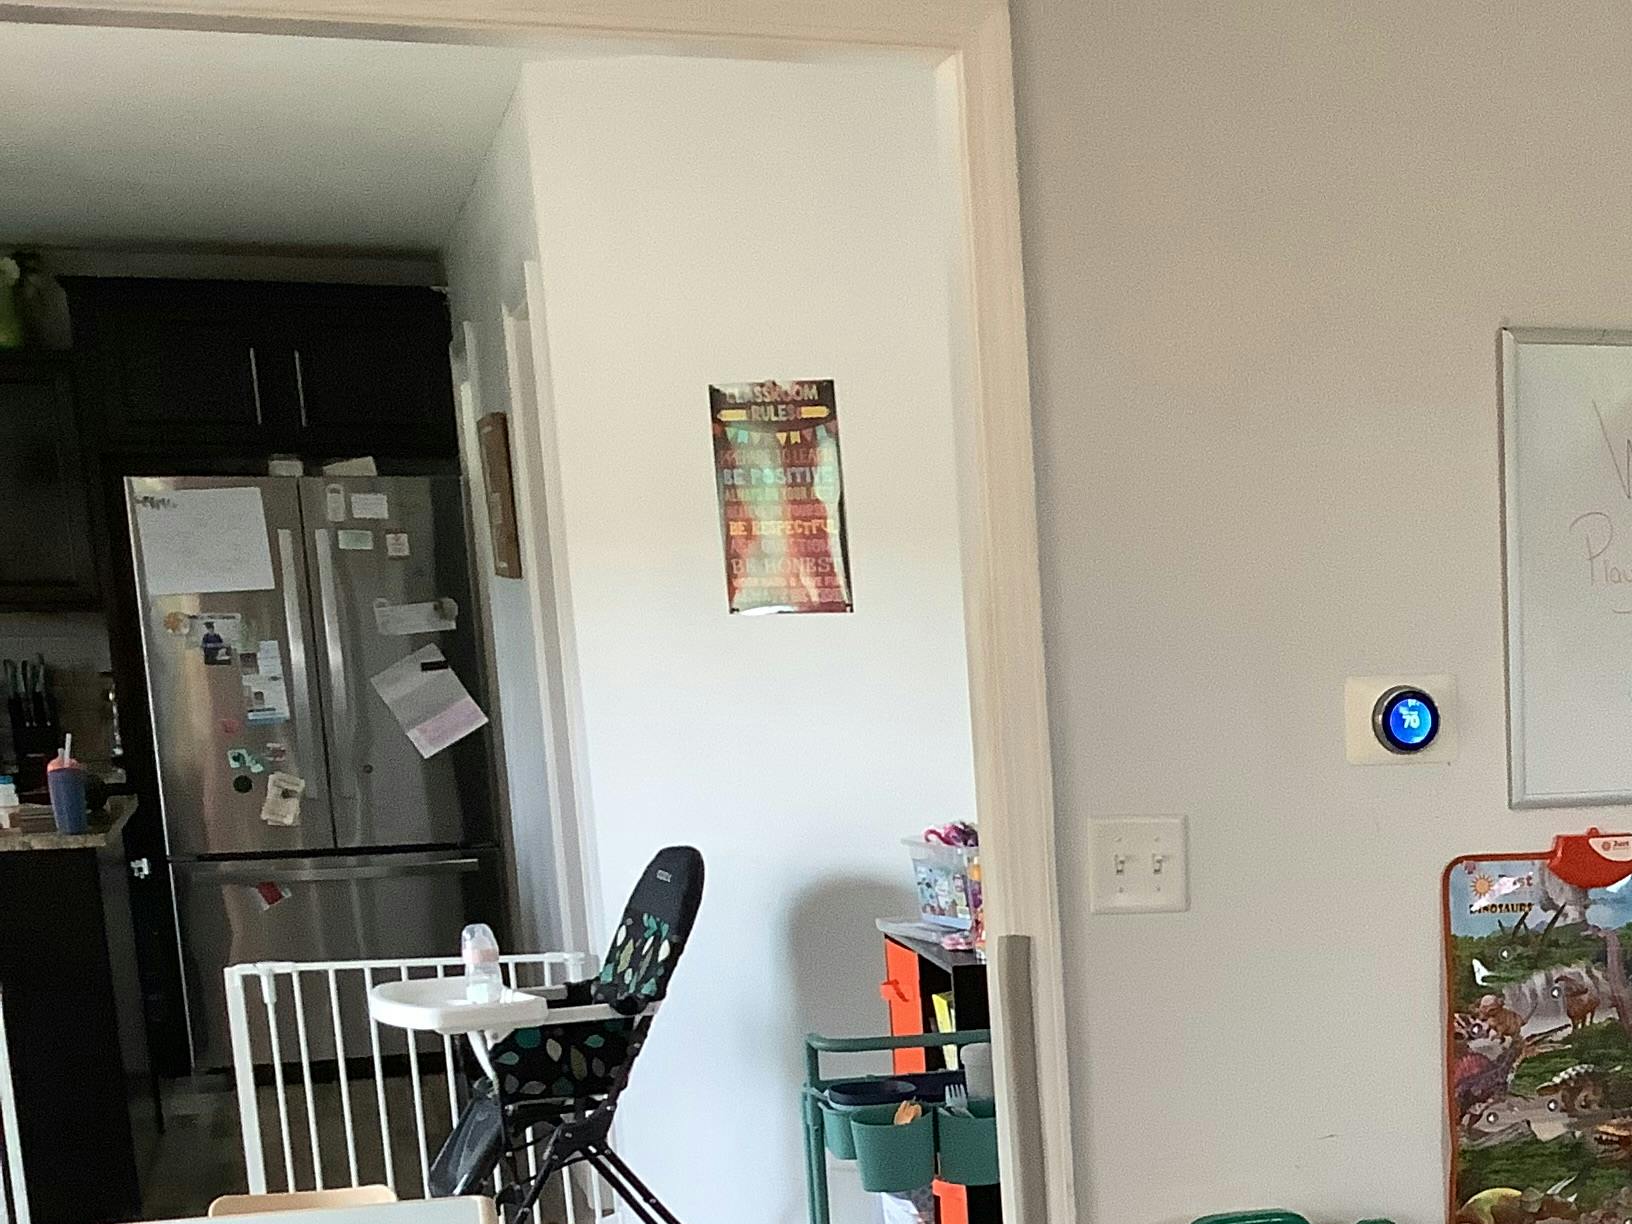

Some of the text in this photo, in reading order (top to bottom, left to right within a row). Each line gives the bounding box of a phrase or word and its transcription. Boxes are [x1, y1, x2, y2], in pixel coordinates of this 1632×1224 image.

[723, 468, 746, 485] BE
[729, 519, 839, 536] BE RESPECTFUL
[1402, 714, 1420, 729] 70
[1469, 903, 1533, 914] NOSAURS
